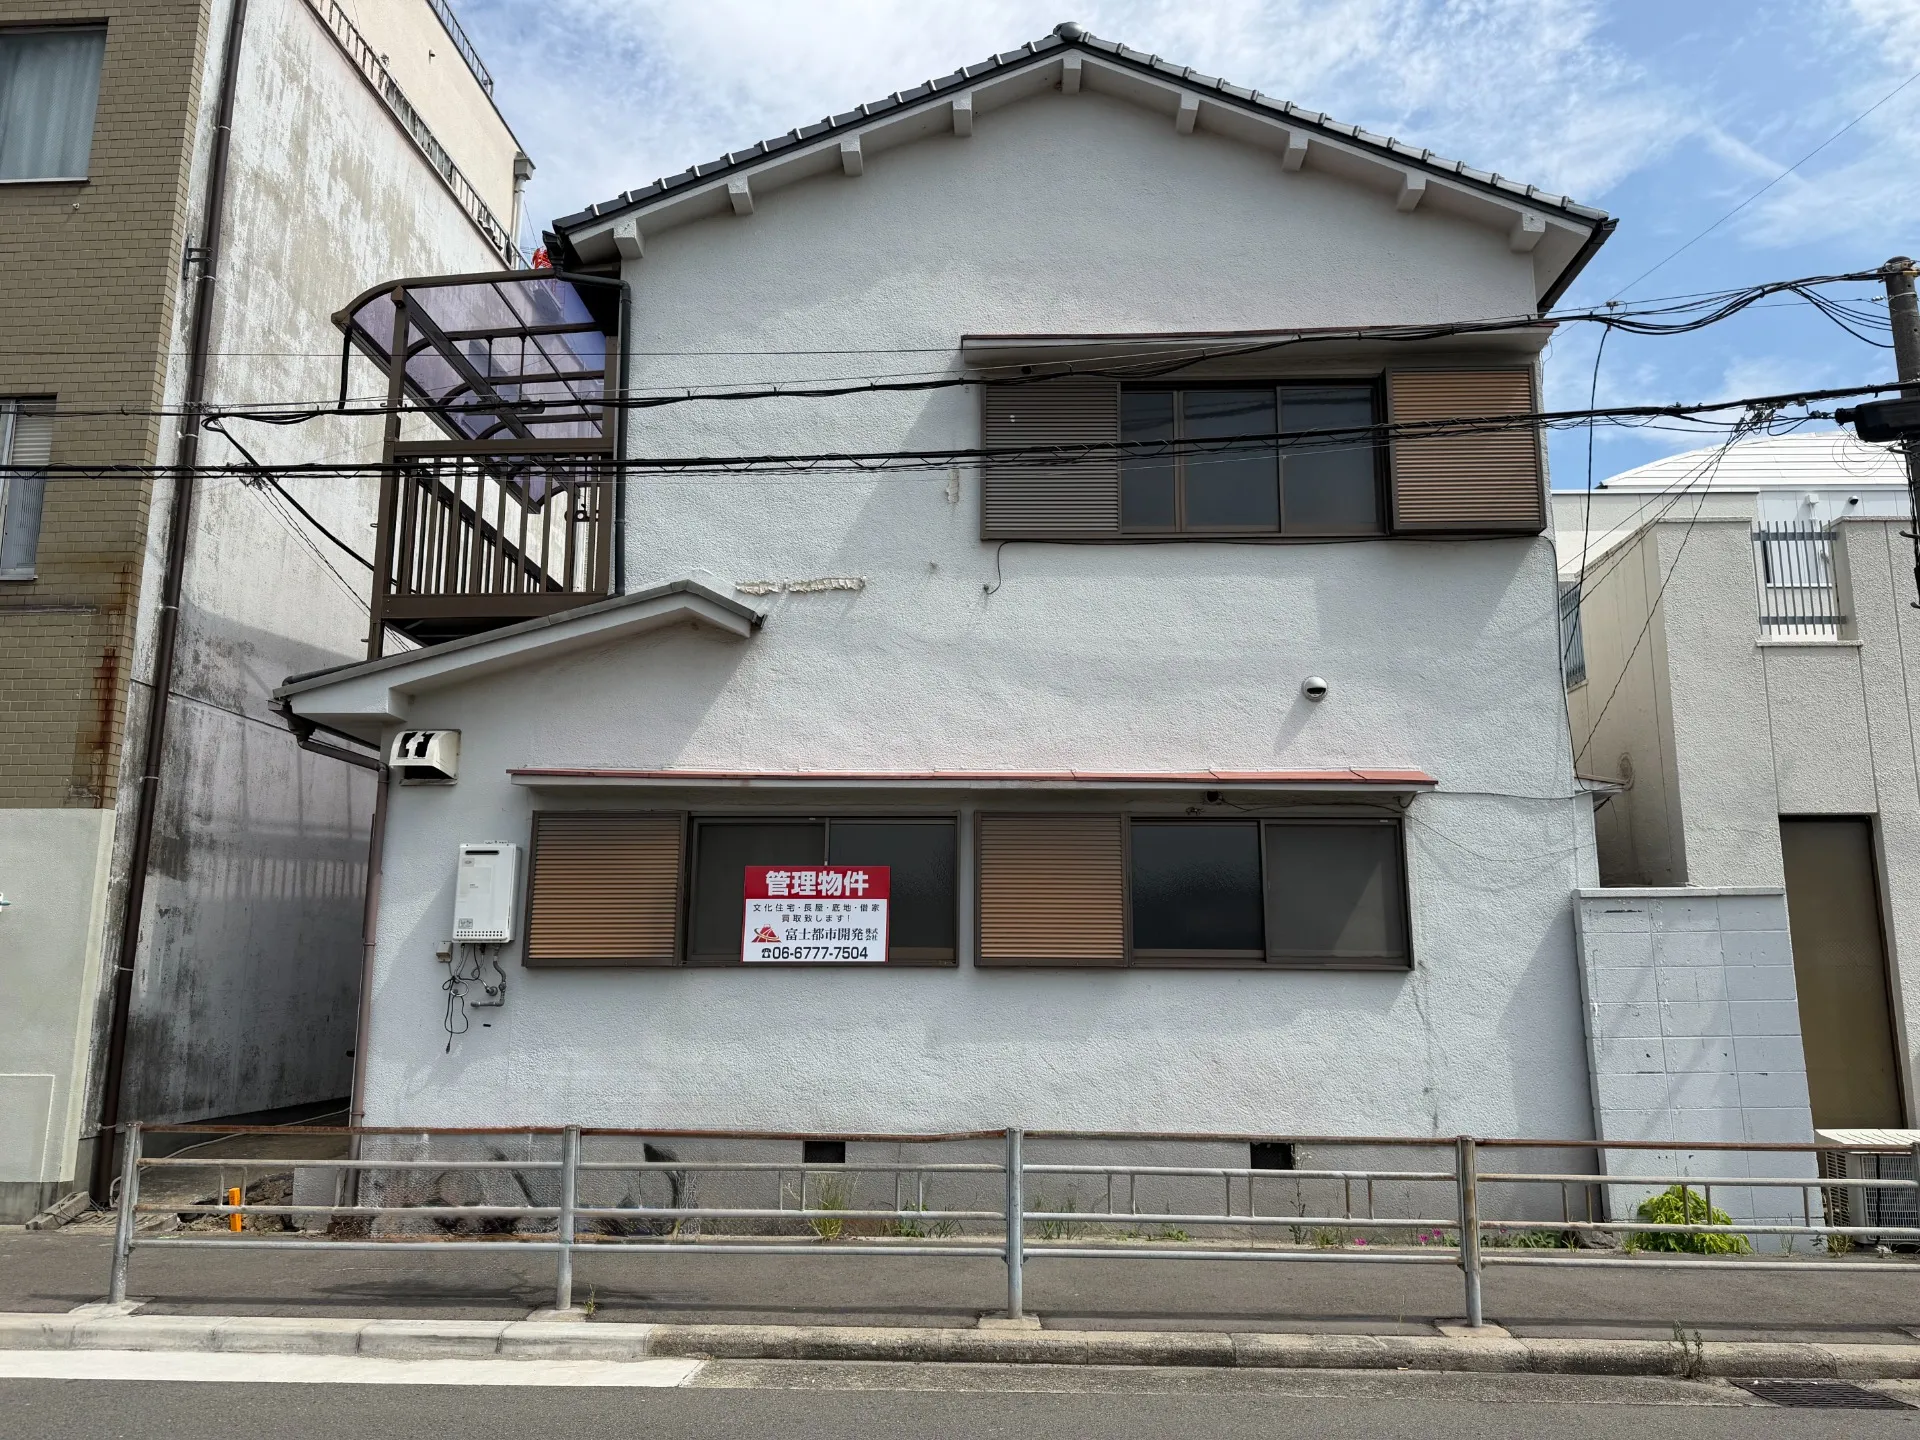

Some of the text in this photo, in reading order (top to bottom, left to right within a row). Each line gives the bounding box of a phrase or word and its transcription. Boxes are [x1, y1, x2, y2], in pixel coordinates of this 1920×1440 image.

[765, 870, 869, 896] 管理物件
[772, 946, 868, 959] 06-6777-7504
